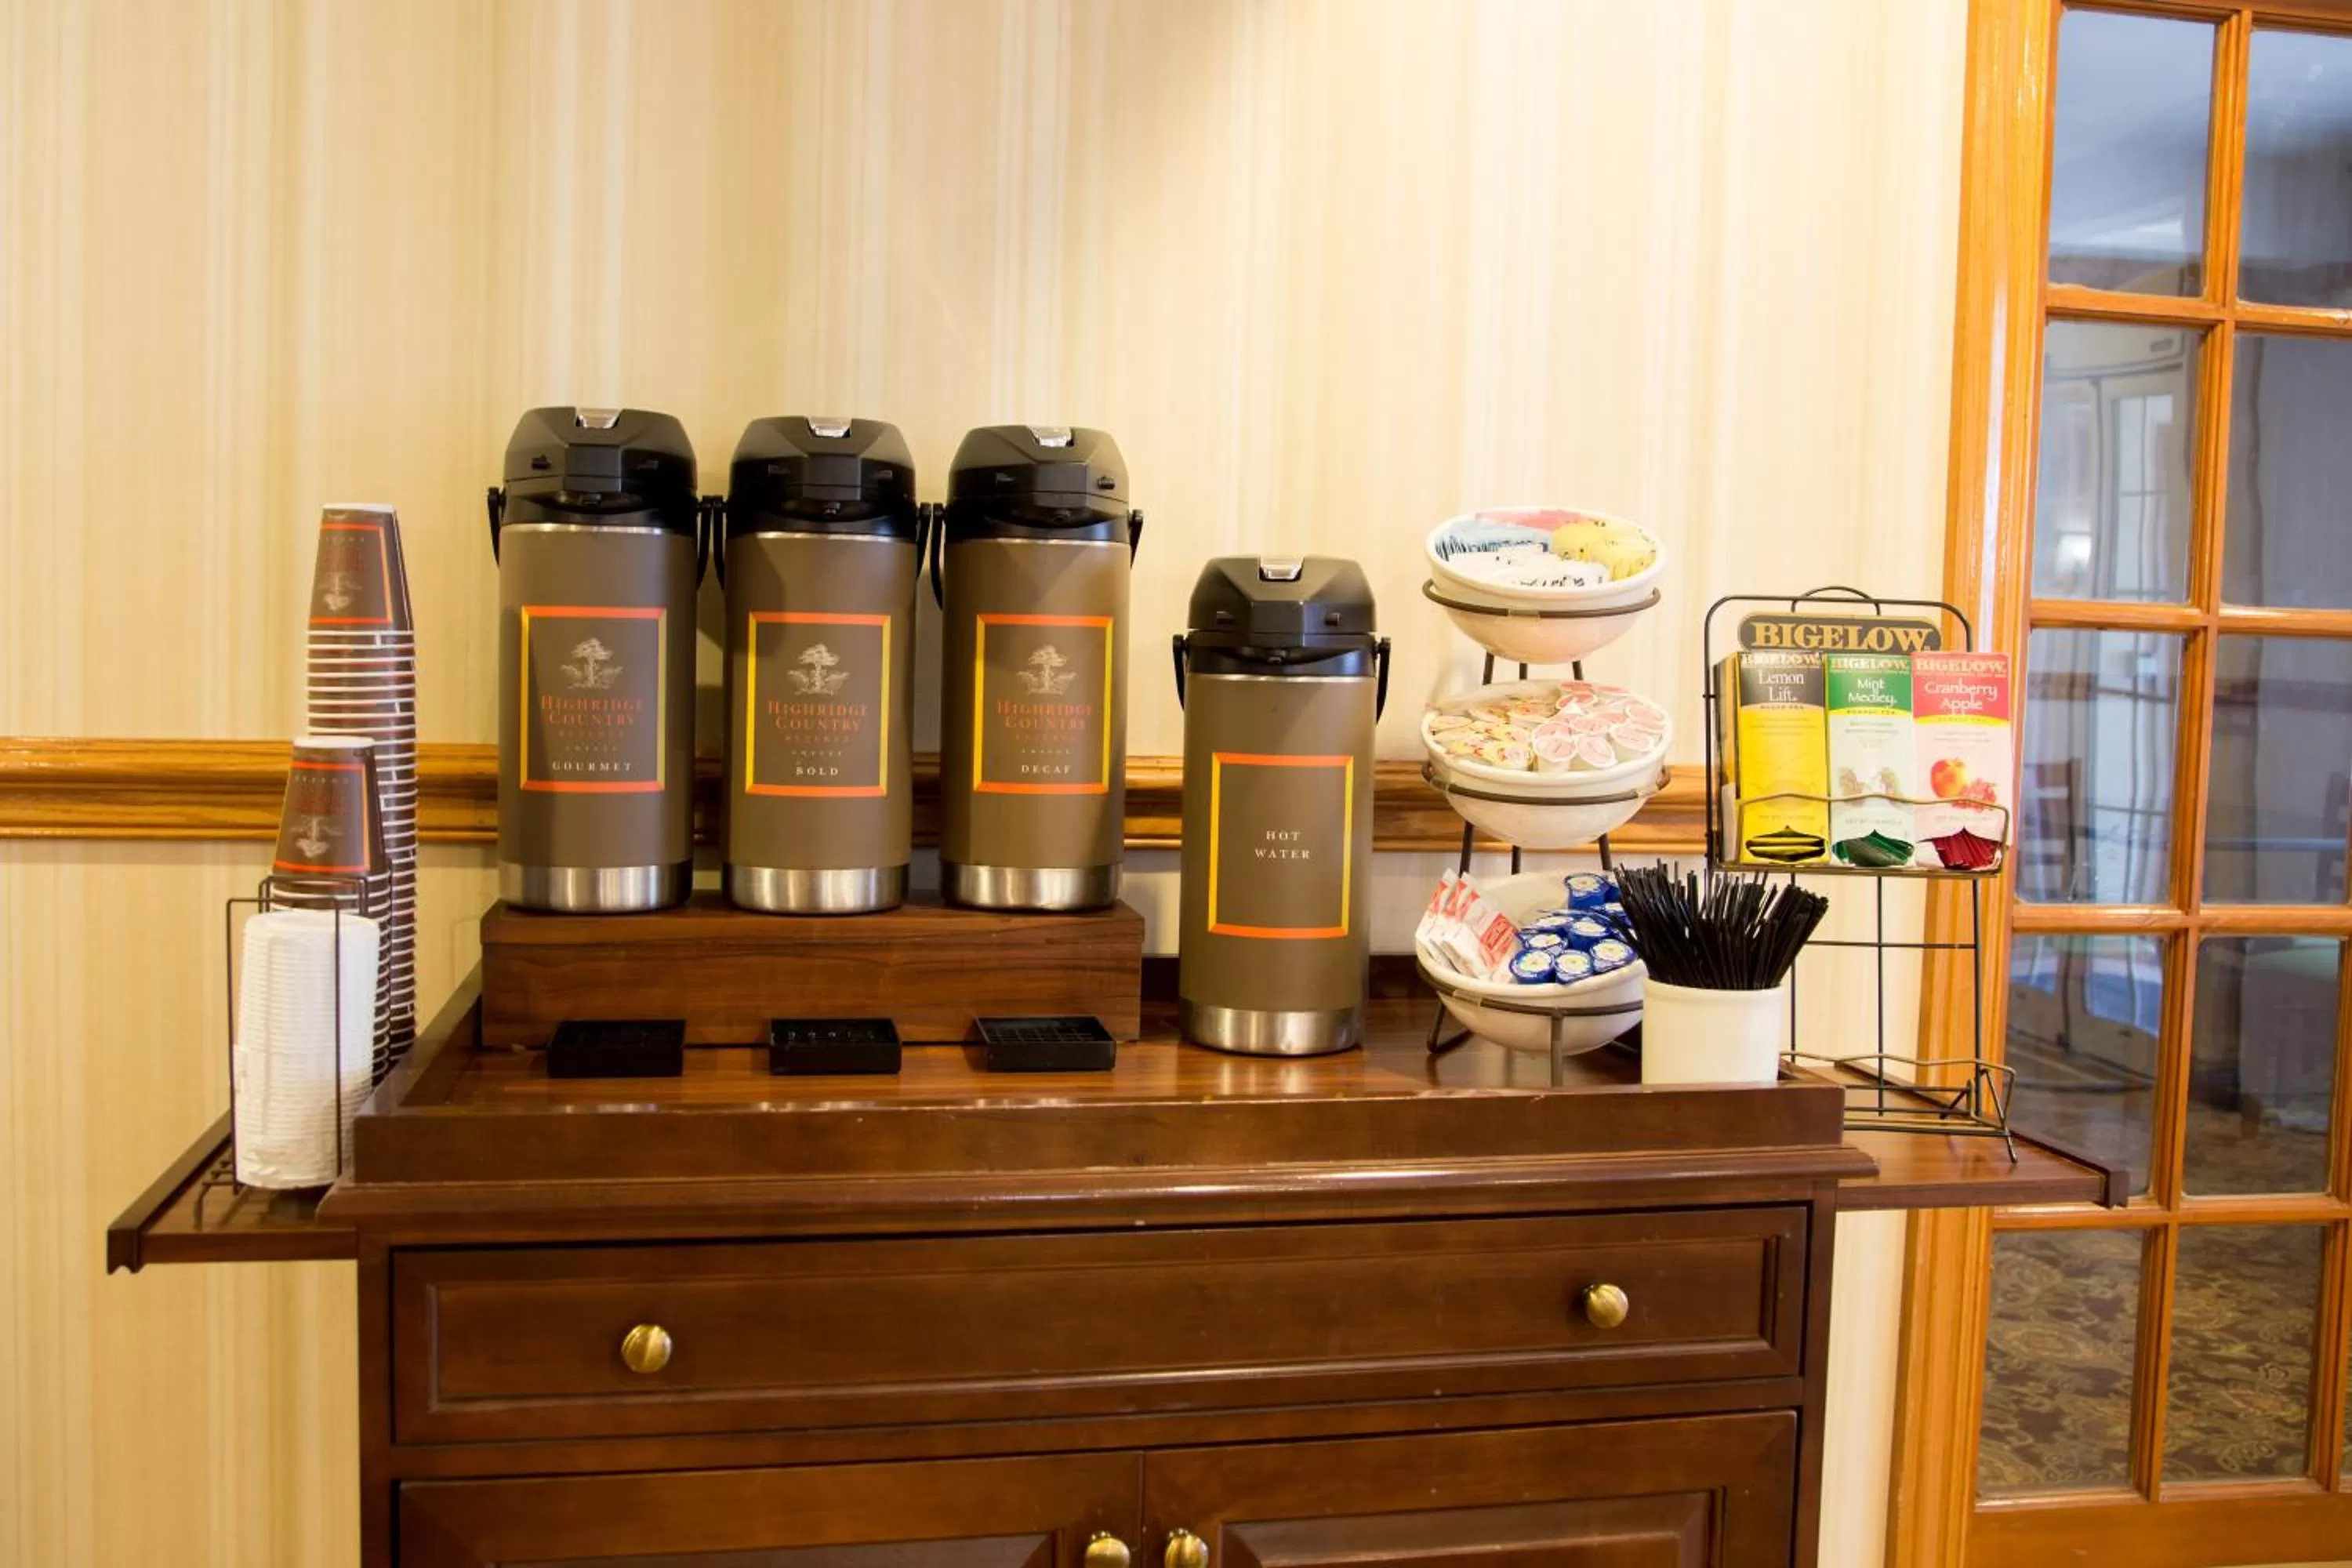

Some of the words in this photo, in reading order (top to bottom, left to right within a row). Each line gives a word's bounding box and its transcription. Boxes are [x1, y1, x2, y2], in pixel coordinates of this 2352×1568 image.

[1758, 669, 1805, 684] Lemon
[1857, 677, 1885, 689] Mint
[1925, 677, 1998, 702] Cranberry
[1939, 695, 1983, 715] Apple
[552, 761, 631, 771] GOURMET
[1022, 764, 1070, 774] DECAF
[1265, 831, 1300, 841] HOT
[1254, 849, 1310, 859] WATER
